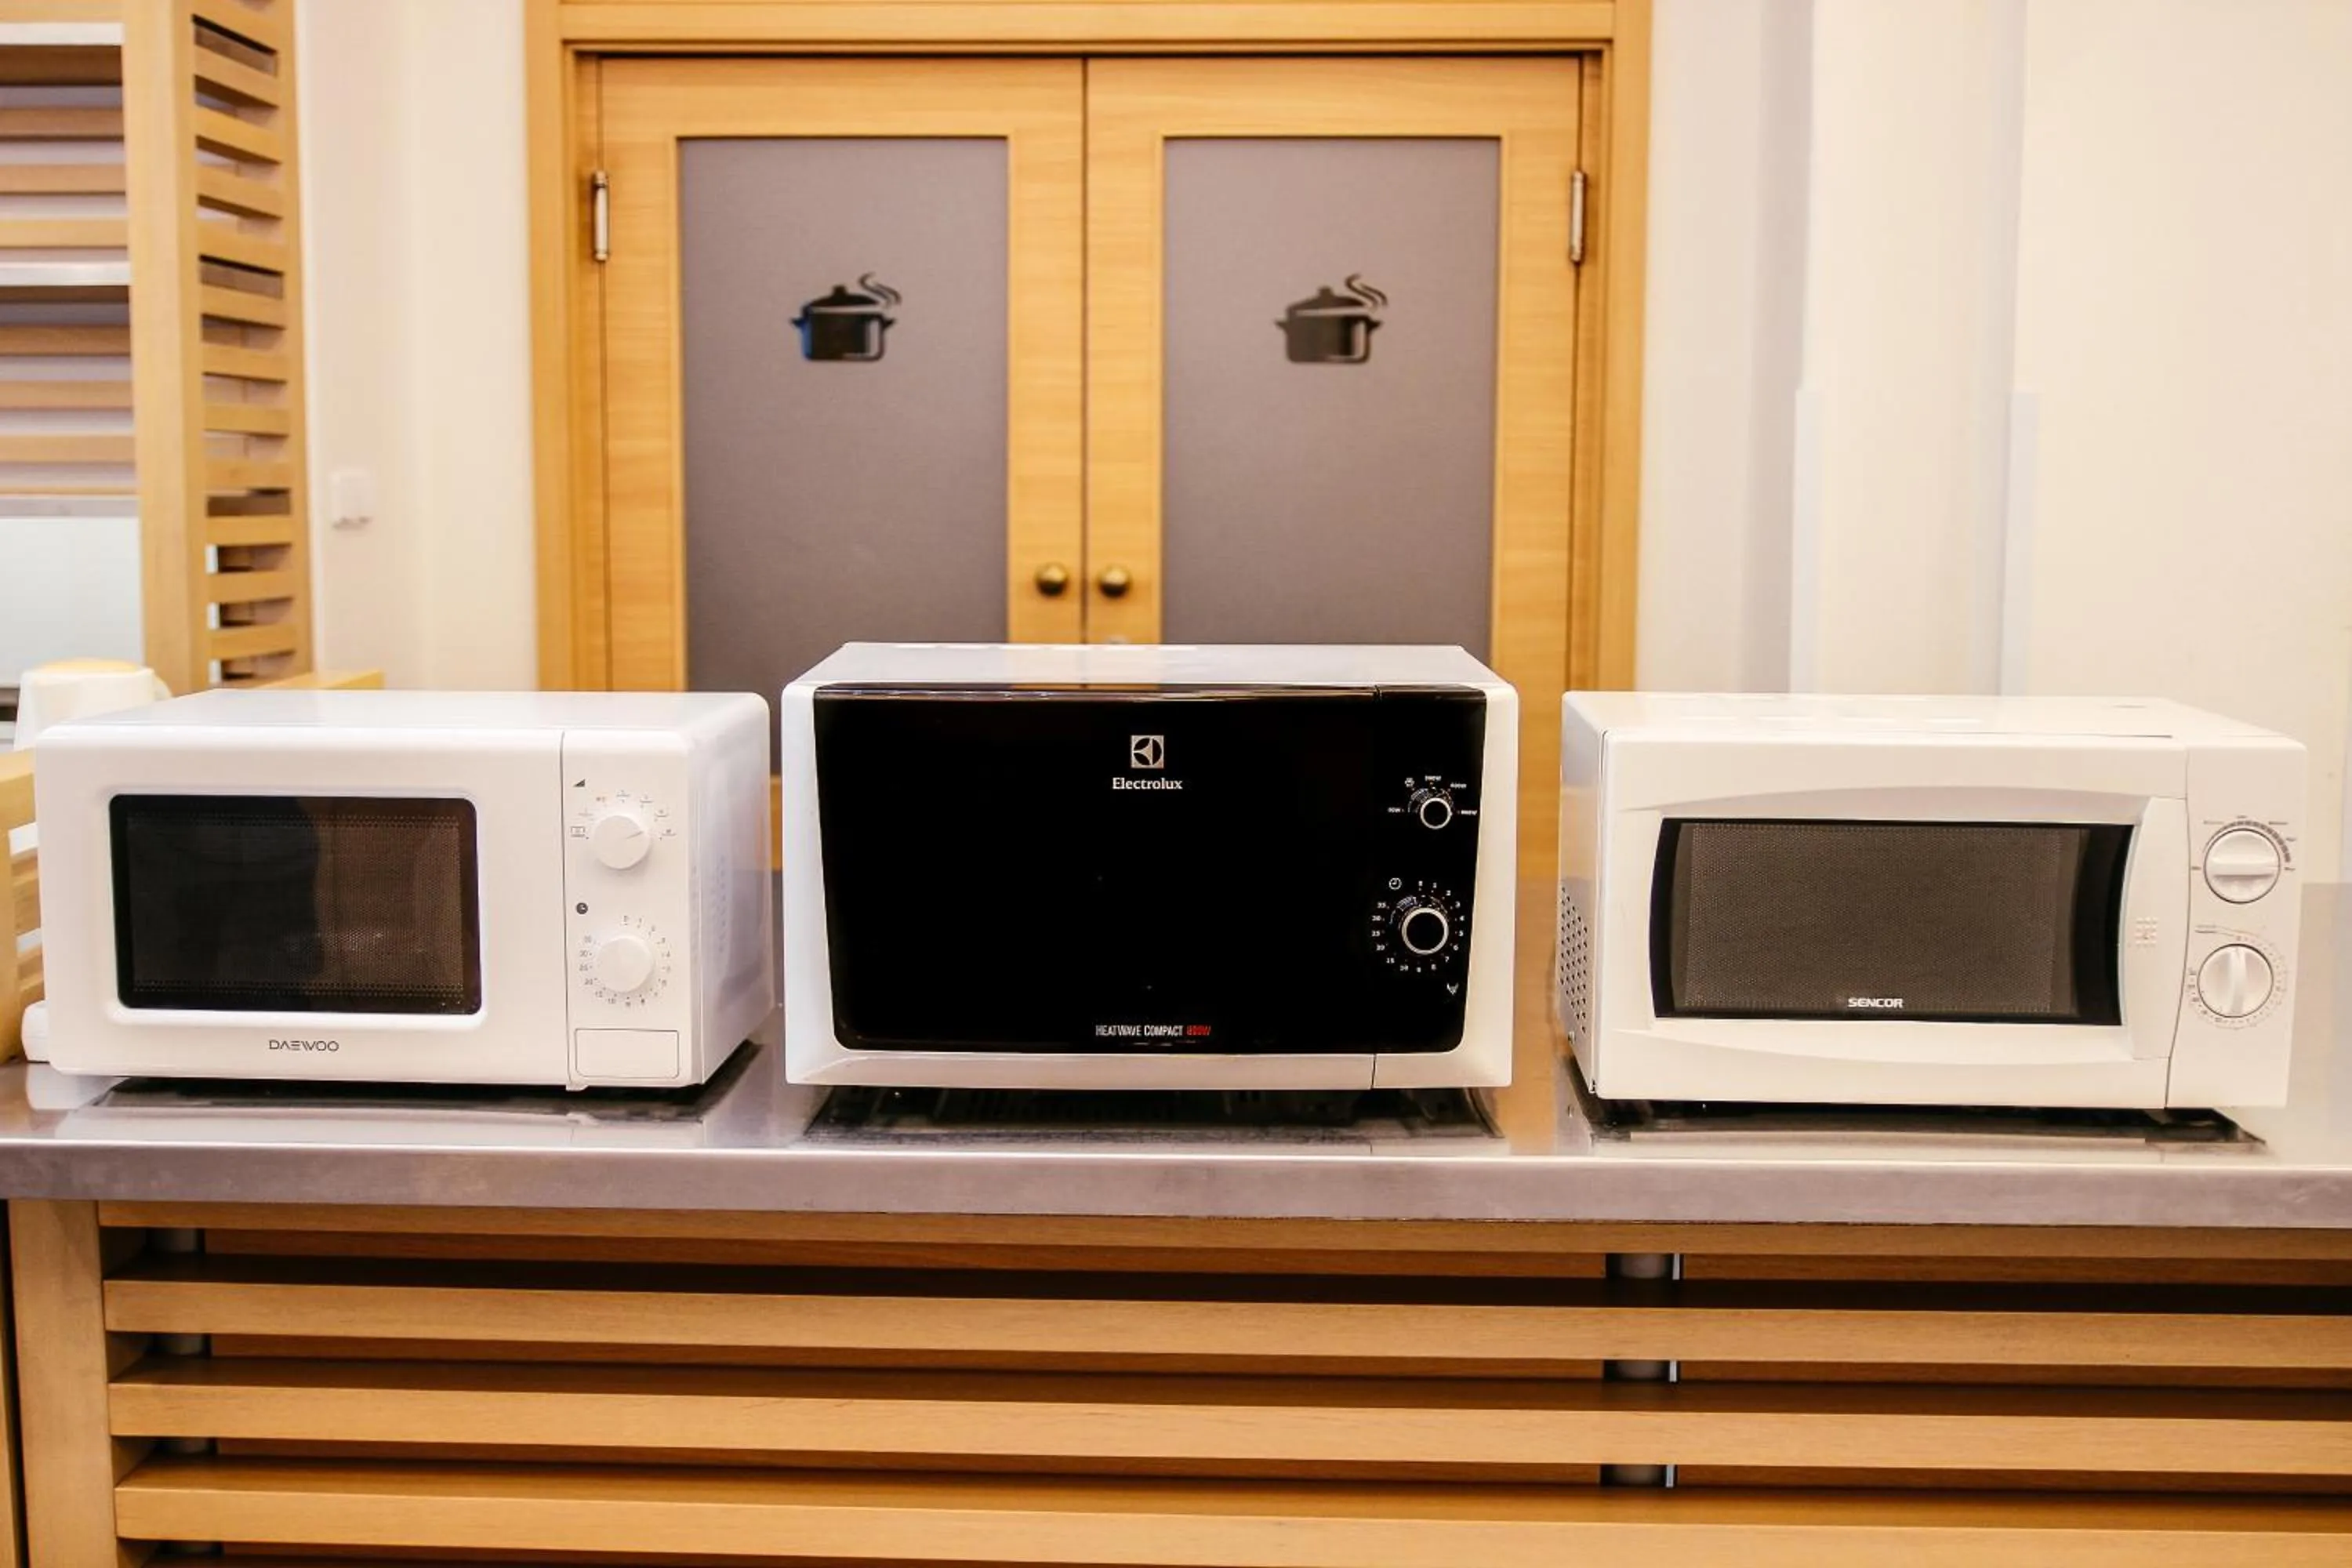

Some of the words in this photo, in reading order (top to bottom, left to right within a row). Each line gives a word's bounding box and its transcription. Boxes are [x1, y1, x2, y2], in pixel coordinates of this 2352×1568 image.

[1112, 777, 1183, 789] Electrolux
[1848, 998, 1904, 1008] SENCOR
[1095, 1025, 1142, 1036] HEATWAVE
[1144, 1025, 1184, 1036] COMPACT
[269, 1040, 339, 1051] DAEWOO
